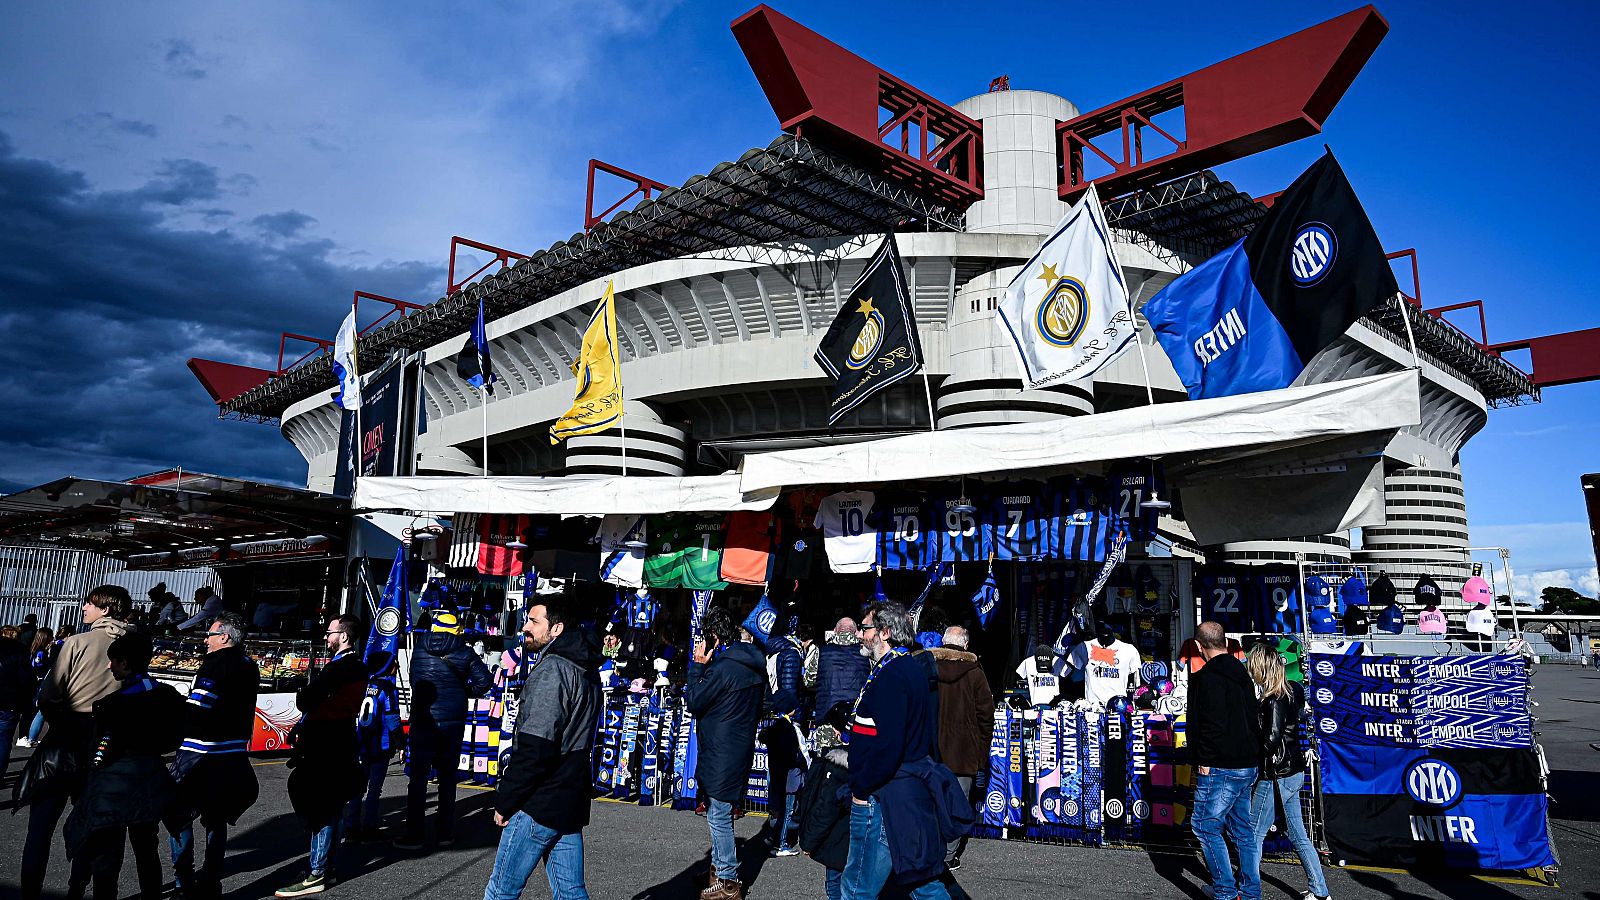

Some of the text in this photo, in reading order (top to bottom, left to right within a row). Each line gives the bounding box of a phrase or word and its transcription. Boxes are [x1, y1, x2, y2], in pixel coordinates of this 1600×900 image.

[1119, 489, 1142, 518] 21
[838, 508, 863, 537] 10
[893, 515, 919, 541] 10
[945, 509, 976, 538] 95
[1006, 510, 1023, 538] 7
[701, 533, 711, 562] 1
[1213, 588, 1239, 613] 22
[1272, 587, 1289, 612] 9
[1361, 663, 1401, 677] INTER
[1429, 664, 1472, 678] EMPOLI
[1360, 692, 1399, 707] INTER
[1427, 694, 1469, 709] EMPOLI
[661, 709, 674, 737] BLACK
[1364, 722, 1404, 738] INTER
[1431, 725, 1475, 739] EMPOLI
[1009, 741, 1021, 773] 1908
[1041, 734, 1057, 770] INTER
[1063, 737, 1078, 774] INTER
[1409, 815, 1479, 844] INTER
